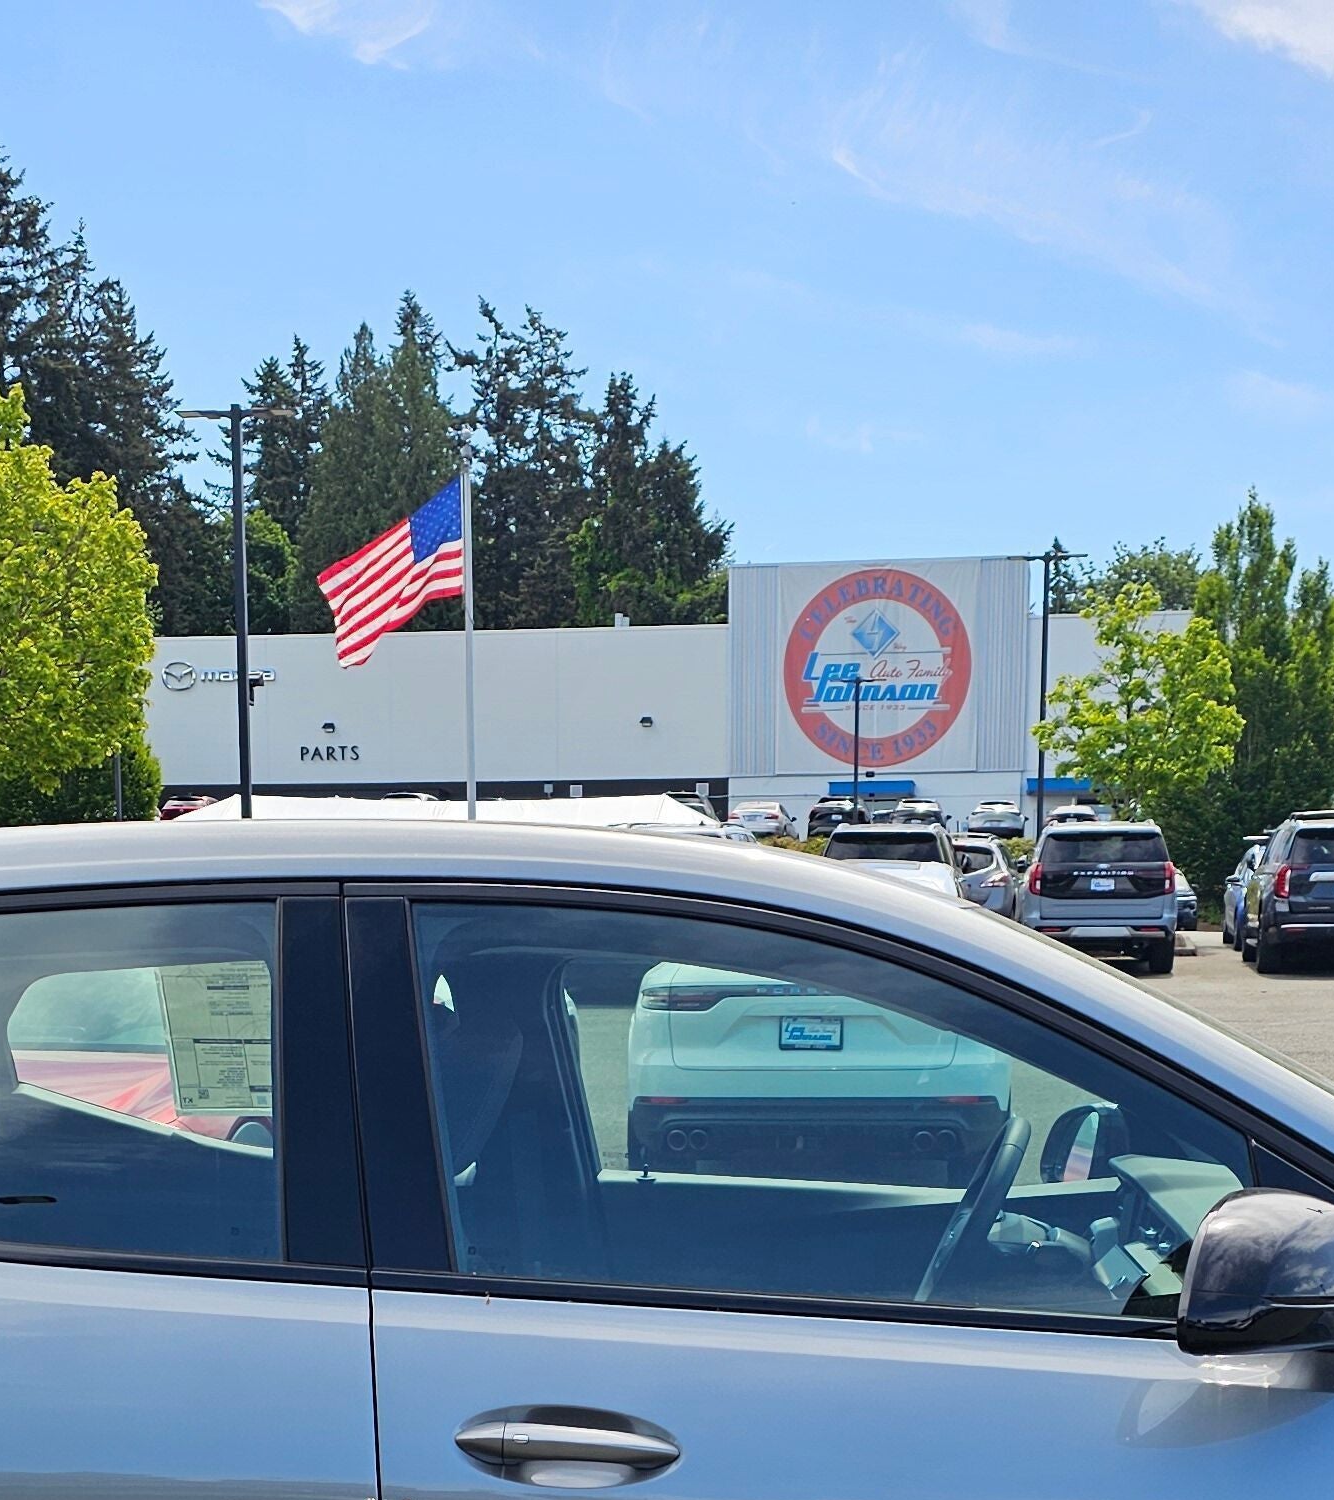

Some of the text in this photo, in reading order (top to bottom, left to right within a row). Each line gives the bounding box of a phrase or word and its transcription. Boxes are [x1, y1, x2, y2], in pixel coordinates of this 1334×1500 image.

[799, 575, 955, 641] CELEBRATING
[803, 652, 953, 685] Lee Auto Family
[805, 678, 941, 702] Johnson
[300, 745, 361, 761] PARTS
[892, 719, 938, 758] 1933
